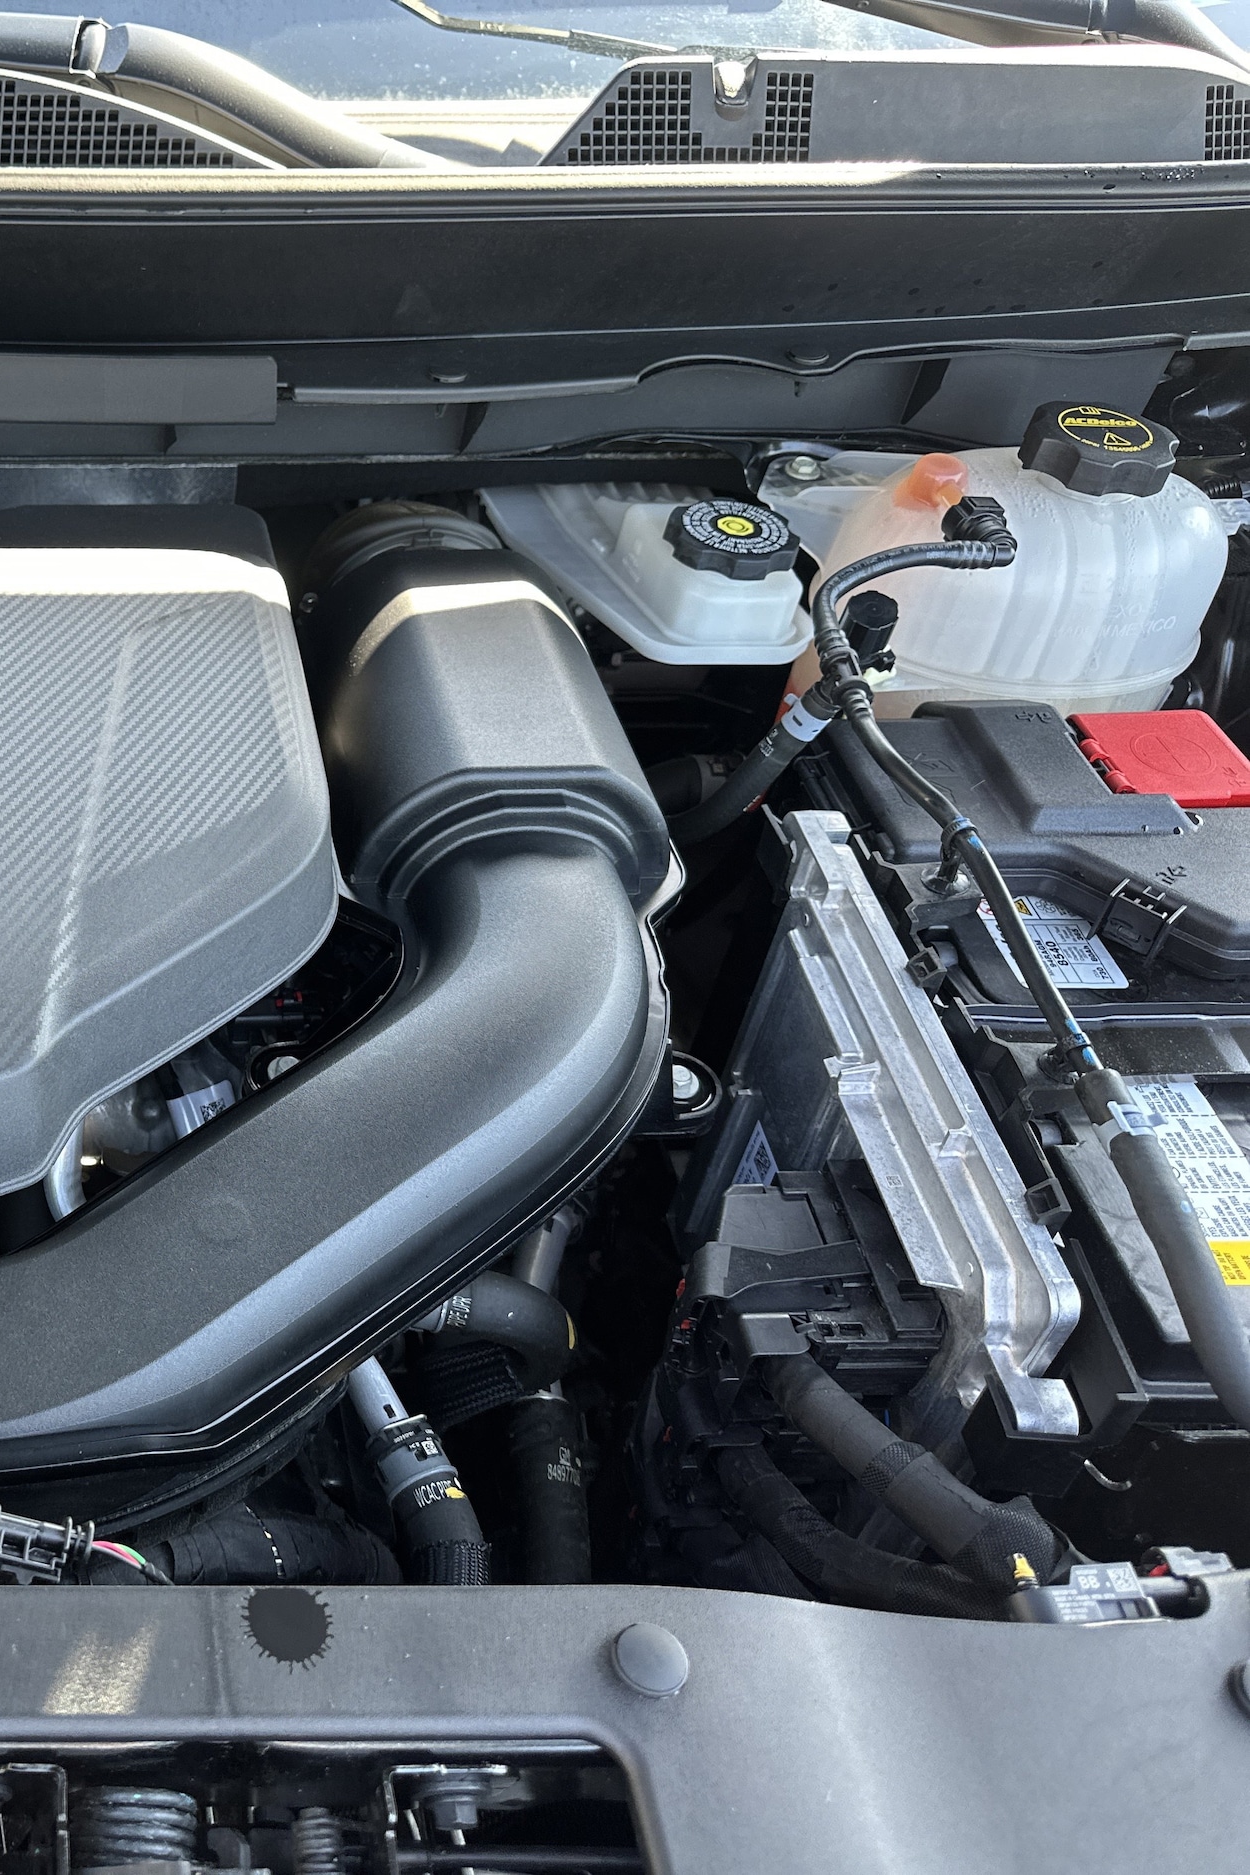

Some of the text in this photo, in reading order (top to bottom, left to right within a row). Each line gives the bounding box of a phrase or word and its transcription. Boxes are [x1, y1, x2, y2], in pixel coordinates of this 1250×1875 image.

[1064, 417, 1138, 427] ACDelco
[1046, 941, 1068, 966] 8540
[413, 1482, 441, 1508] WCAC
[1077, 1575, 1100, 1589] BB
